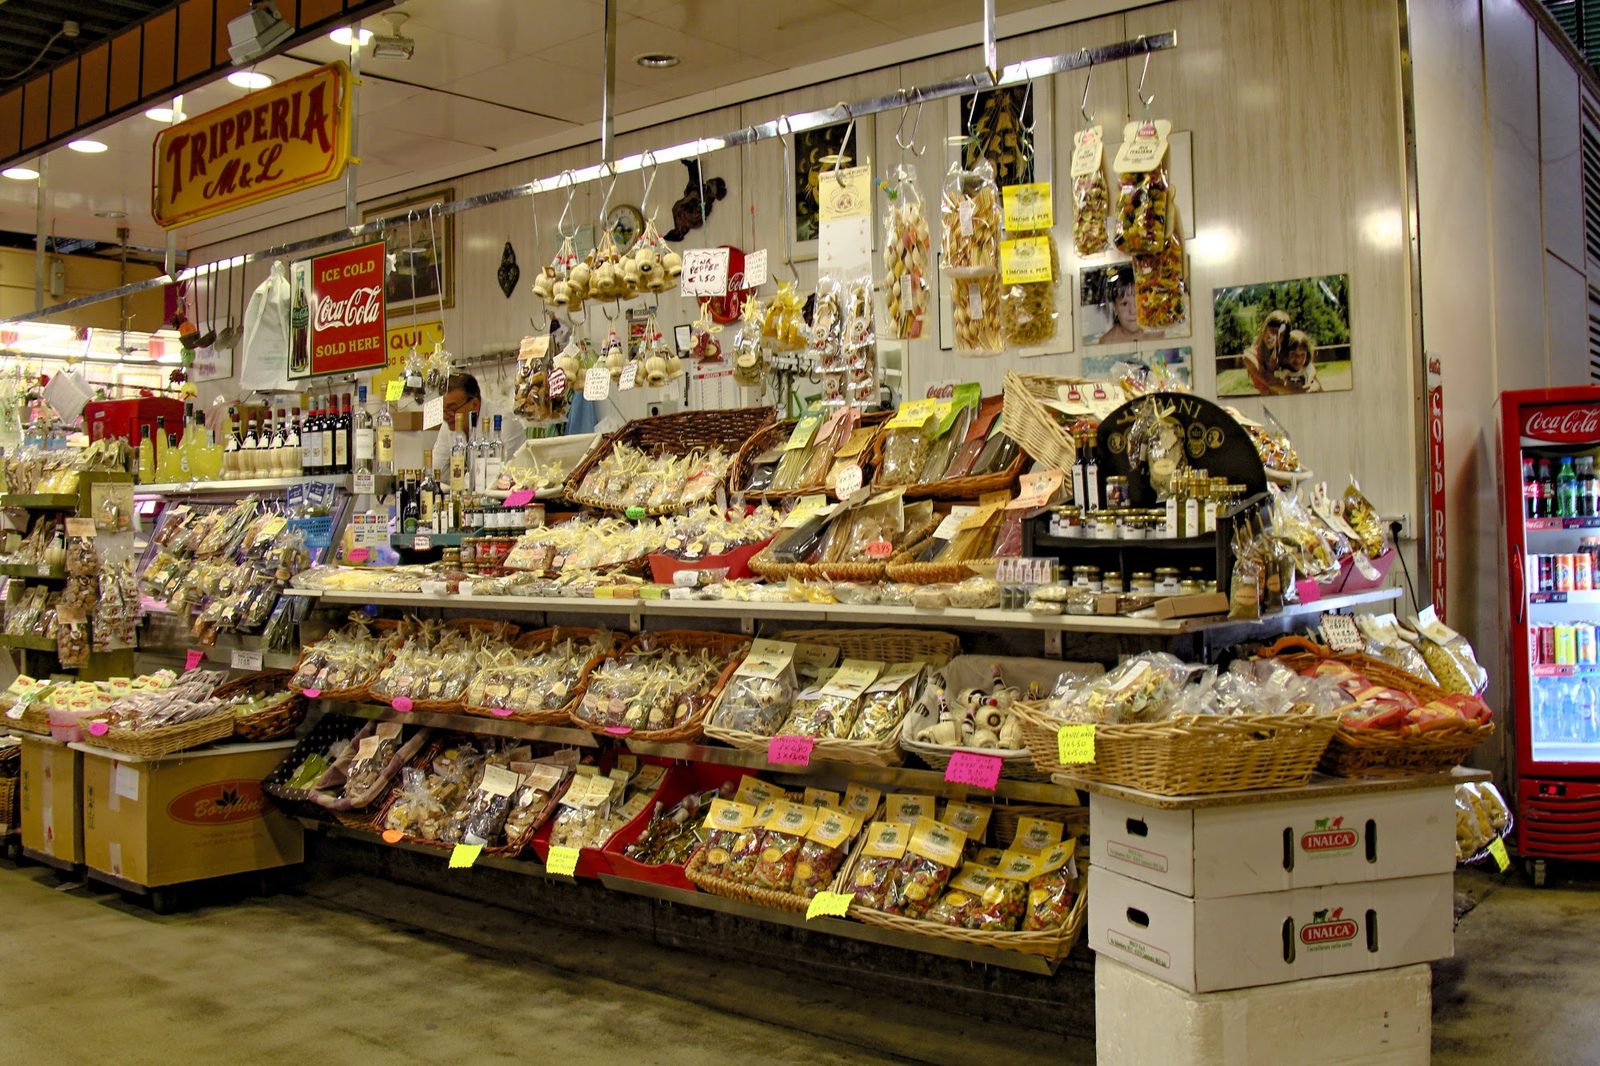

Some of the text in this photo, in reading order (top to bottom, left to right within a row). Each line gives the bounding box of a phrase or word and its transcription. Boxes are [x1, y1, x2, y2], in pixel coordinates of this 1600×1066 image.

[166, 81, 331, 204] TRIPPERIA
[321, 260, 375, 283] ICE COLD
[314, 285, 381, 332] Coca-Cola
[315, 336, 380, 358] SOLD HERE
[390, 331, 422, 350] QUI
[1525, 408, 1600, 436] Coca-Cola
[1432, 392, 1444, 493] COLD
[1434, 510, 1444, 623] DRIN
[1307, 834, 1350, 848] INALCA
[1307, 926, 1350, 941] INALCA
